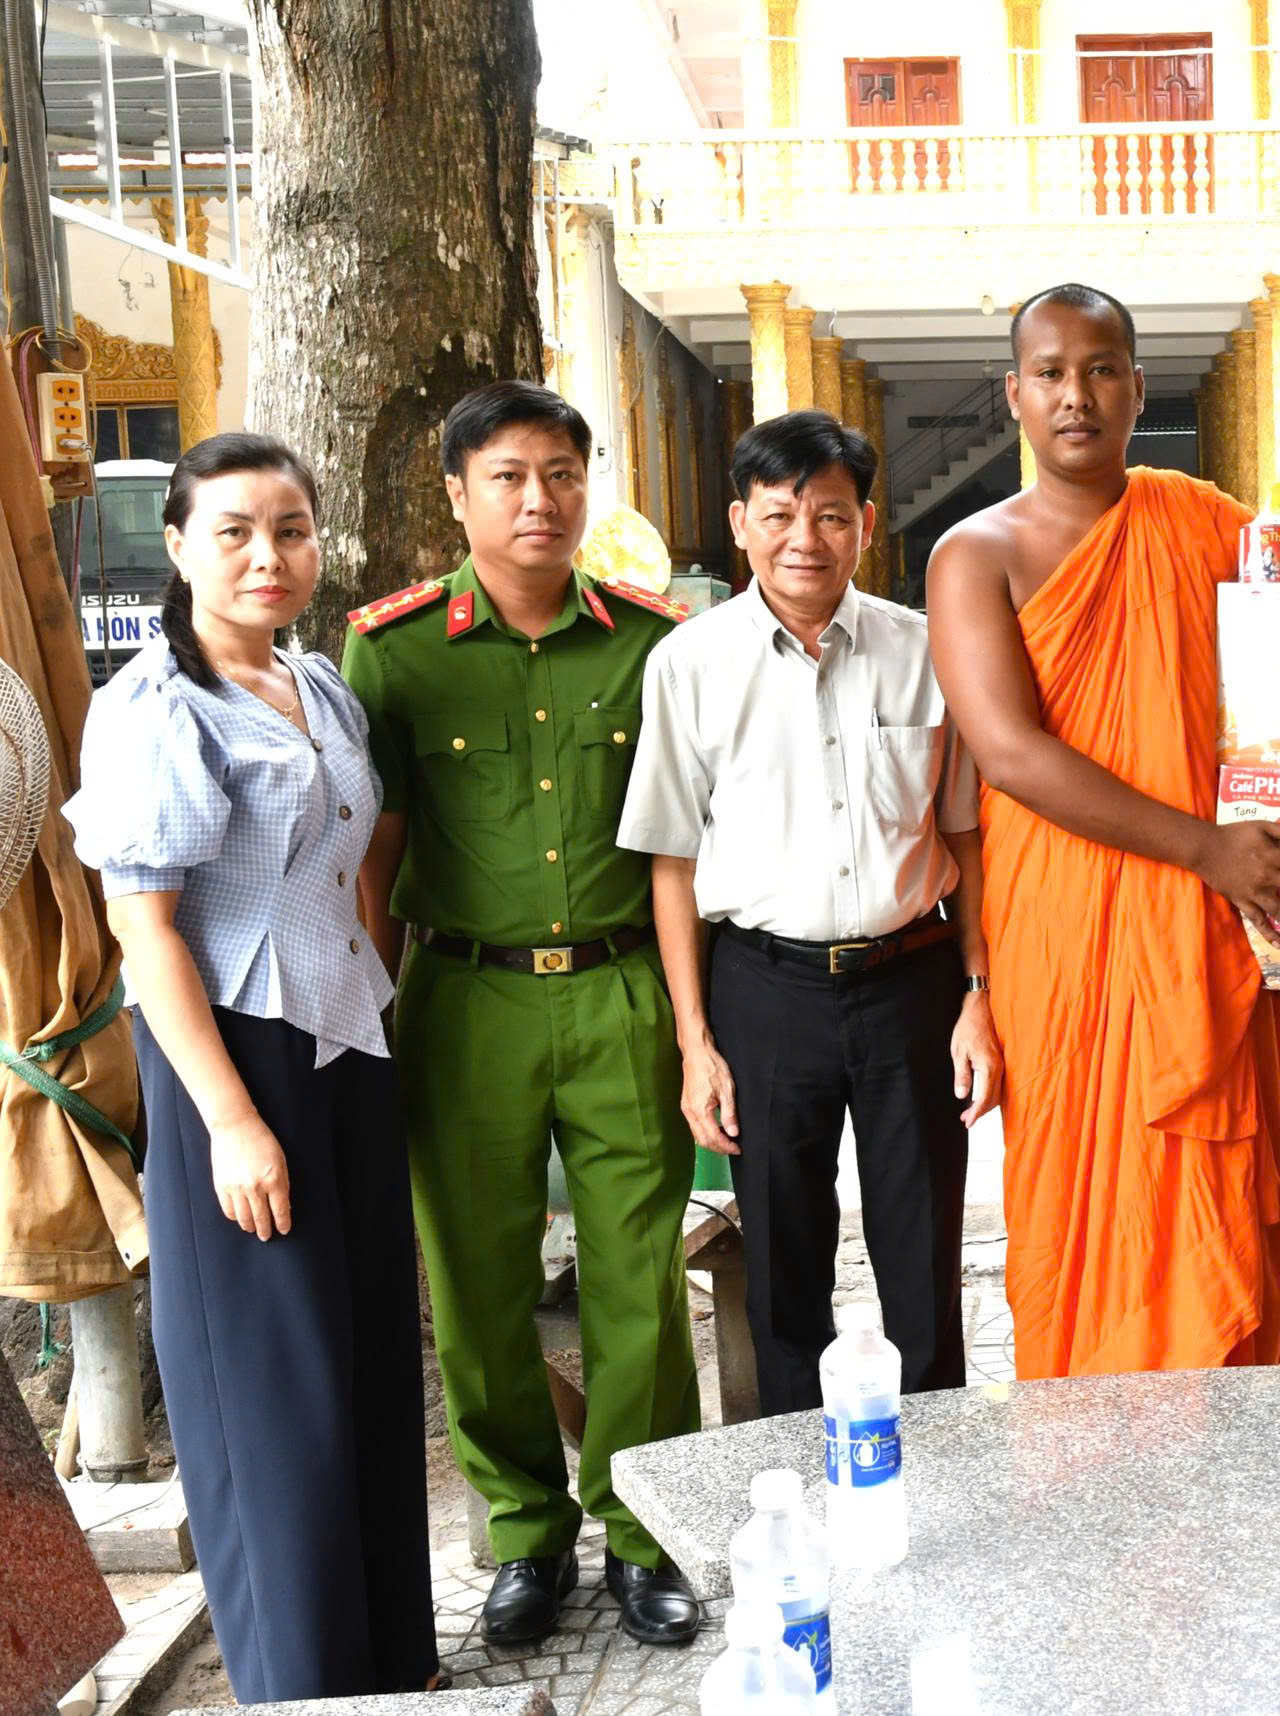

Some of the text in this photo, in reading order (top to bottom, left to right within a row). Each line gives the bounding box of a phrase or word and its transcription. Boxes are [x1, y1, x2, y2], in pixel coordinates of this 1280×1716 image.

[81, 593, 140, 606] ISUZU
[96, 611, 141, 642] HÒN
[1229, 780, 1254, 793] Café
